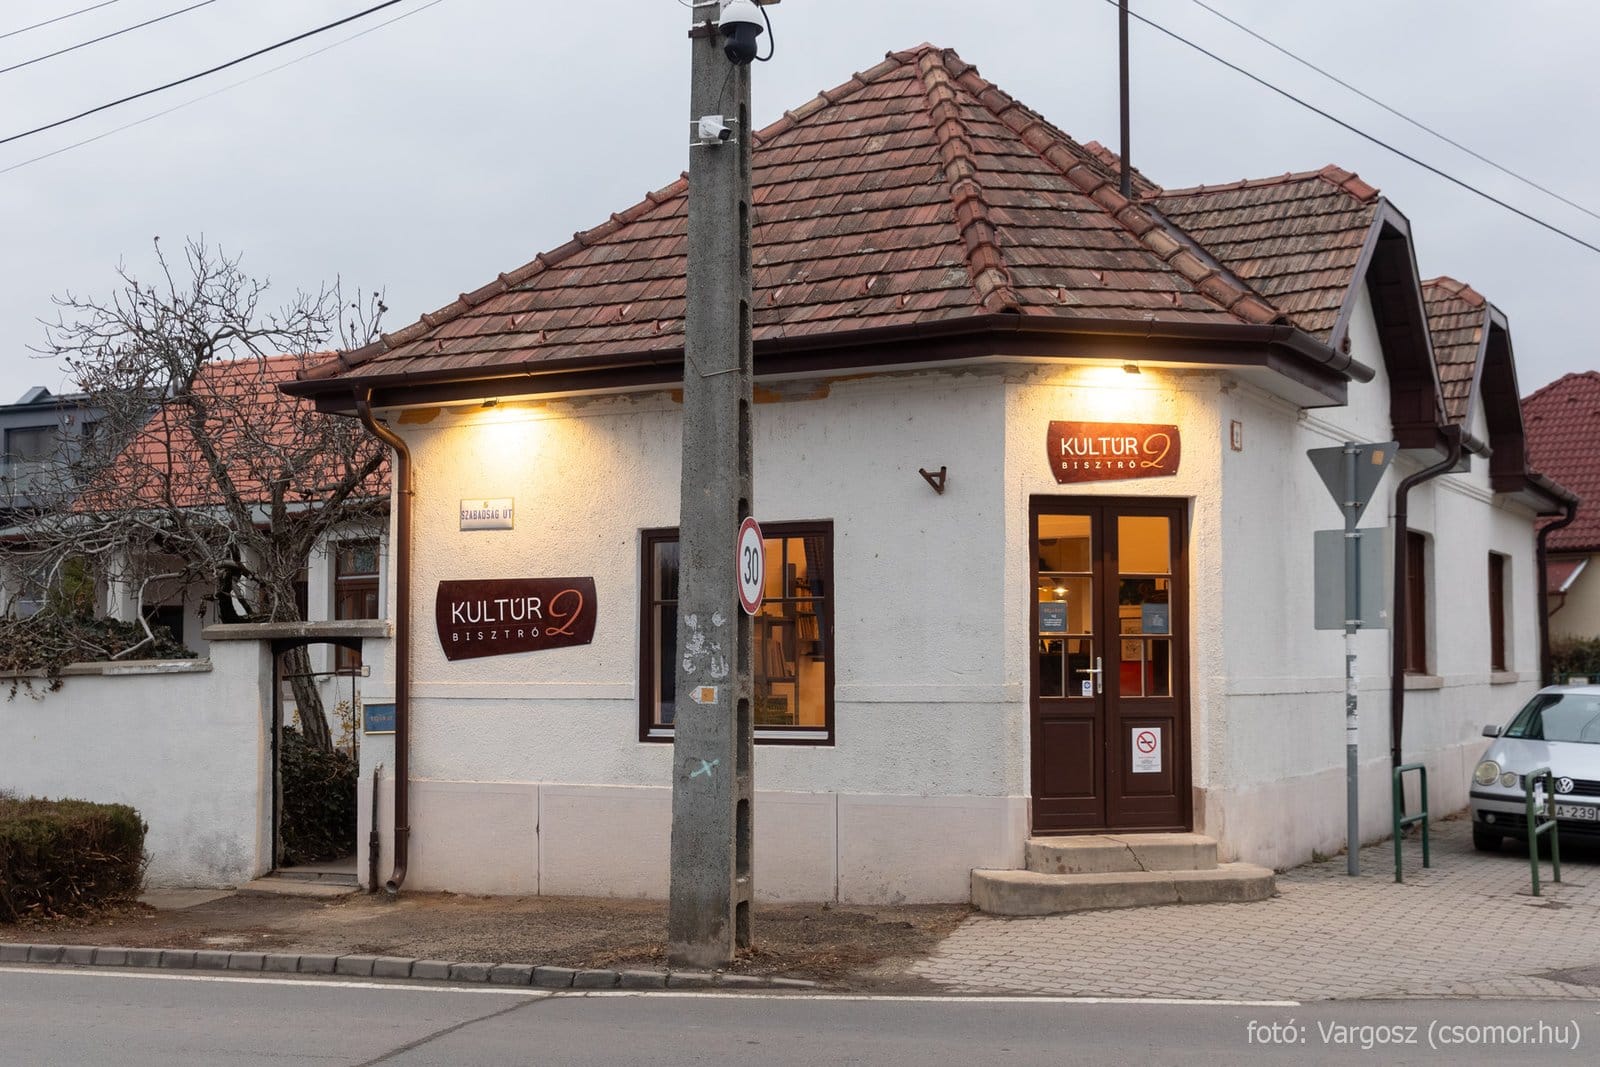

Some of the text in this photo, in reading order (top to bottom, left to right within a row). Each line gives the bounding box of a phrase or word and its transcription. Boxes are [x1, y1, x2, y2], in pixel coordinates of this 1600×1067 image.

[1061, 432, 1171, 469] KULTÚR 2
[1062, 460, 1136, 469] BISZTRÓ
[743, 545, 759, 586] 30
[451, 588, 584, 636] KULTÚR 2
[452, 626, 540, 642] BISZTRÓ
